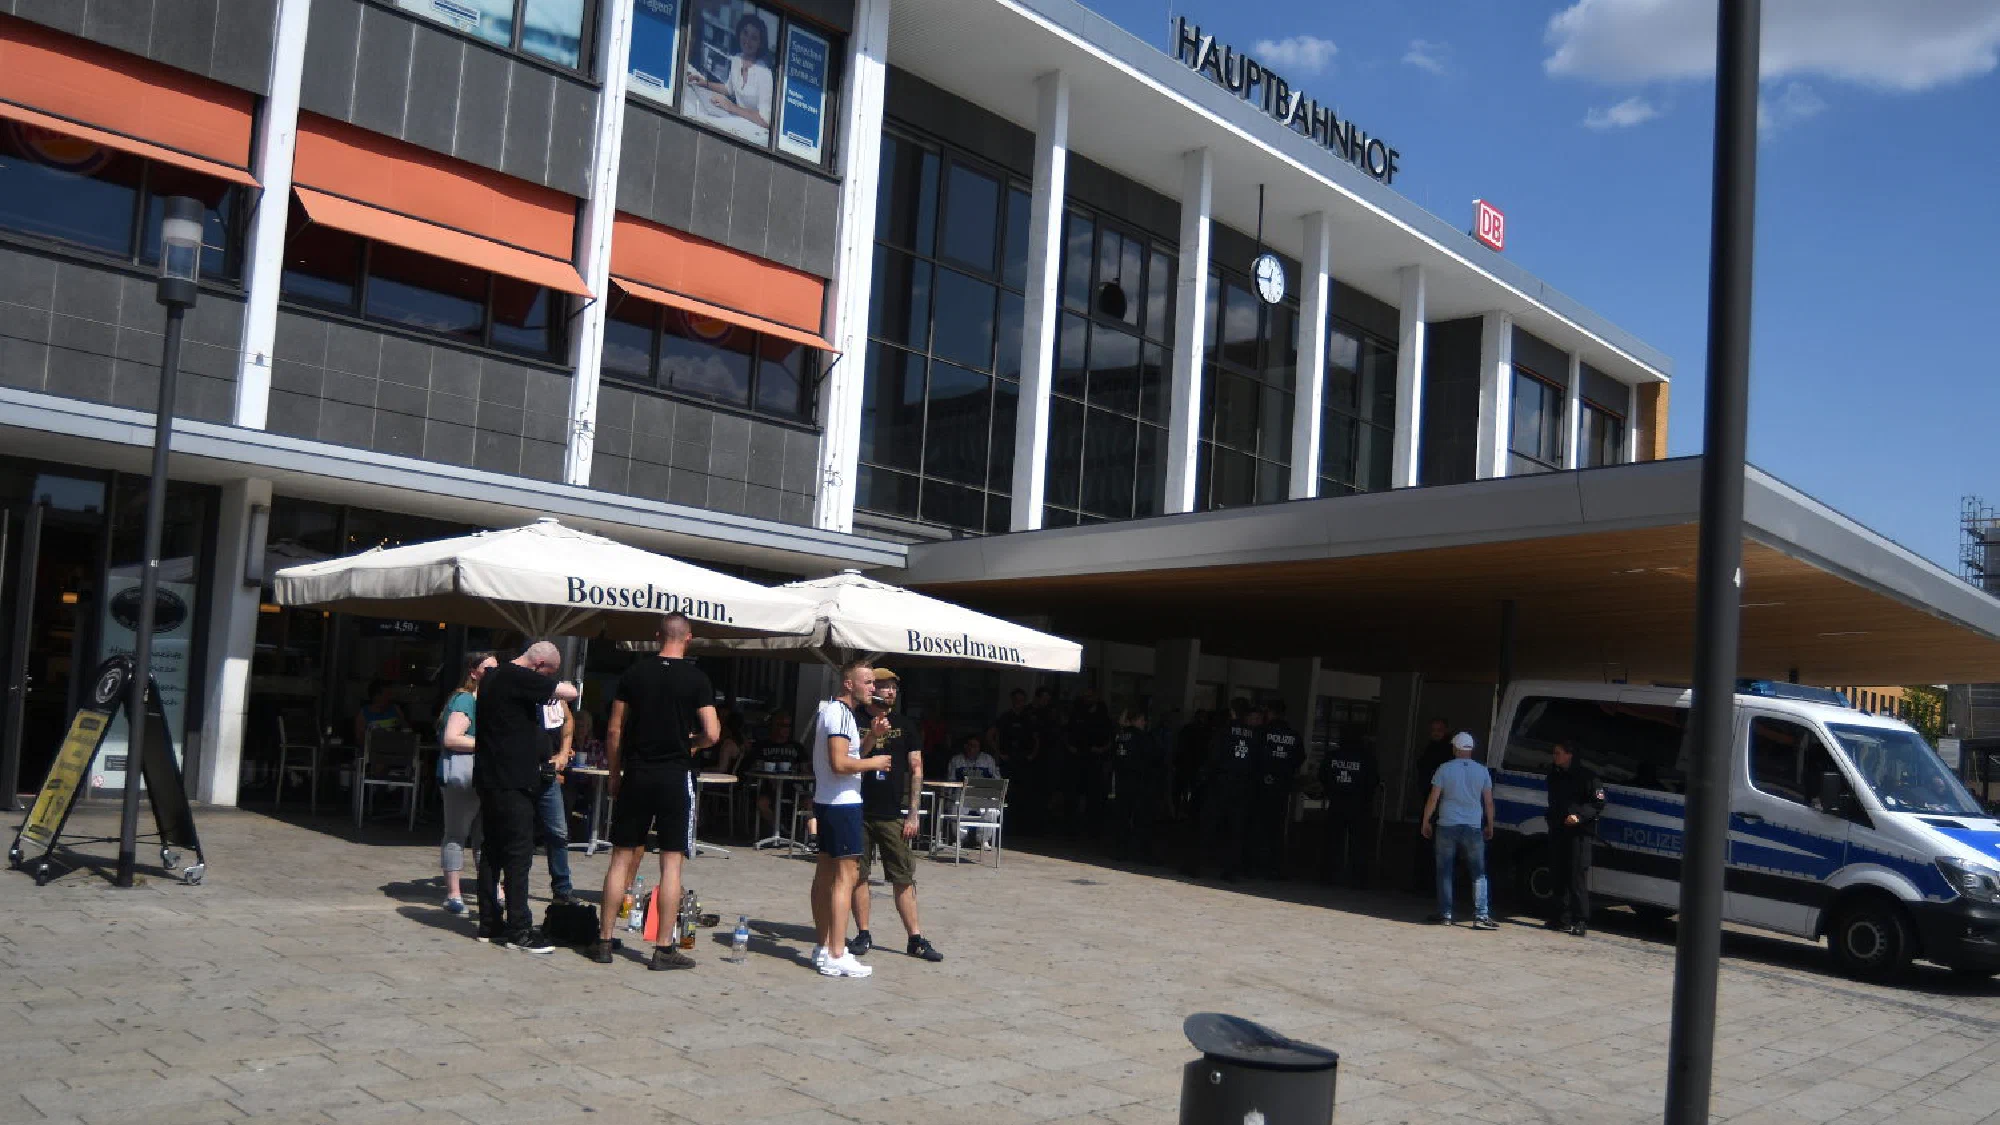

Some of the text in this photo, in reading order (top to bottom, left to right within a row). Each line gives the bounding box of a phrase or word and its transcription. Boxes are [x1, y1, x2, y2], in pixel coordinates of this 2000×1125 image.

[1173, 16, 1400, 185] HAUPTBAHNHOF
[1482, 206, 1502, 244] DB
[566, 576, 733, 623] Bosselmann.
[907, 629, 1025, 663] Bosselmann.
[1266, 733, 1295, 746] POLIZEI
[1331, 759, 1360, 771] POLIZEI
[1623, 827, 1682, 850] POLIZE
